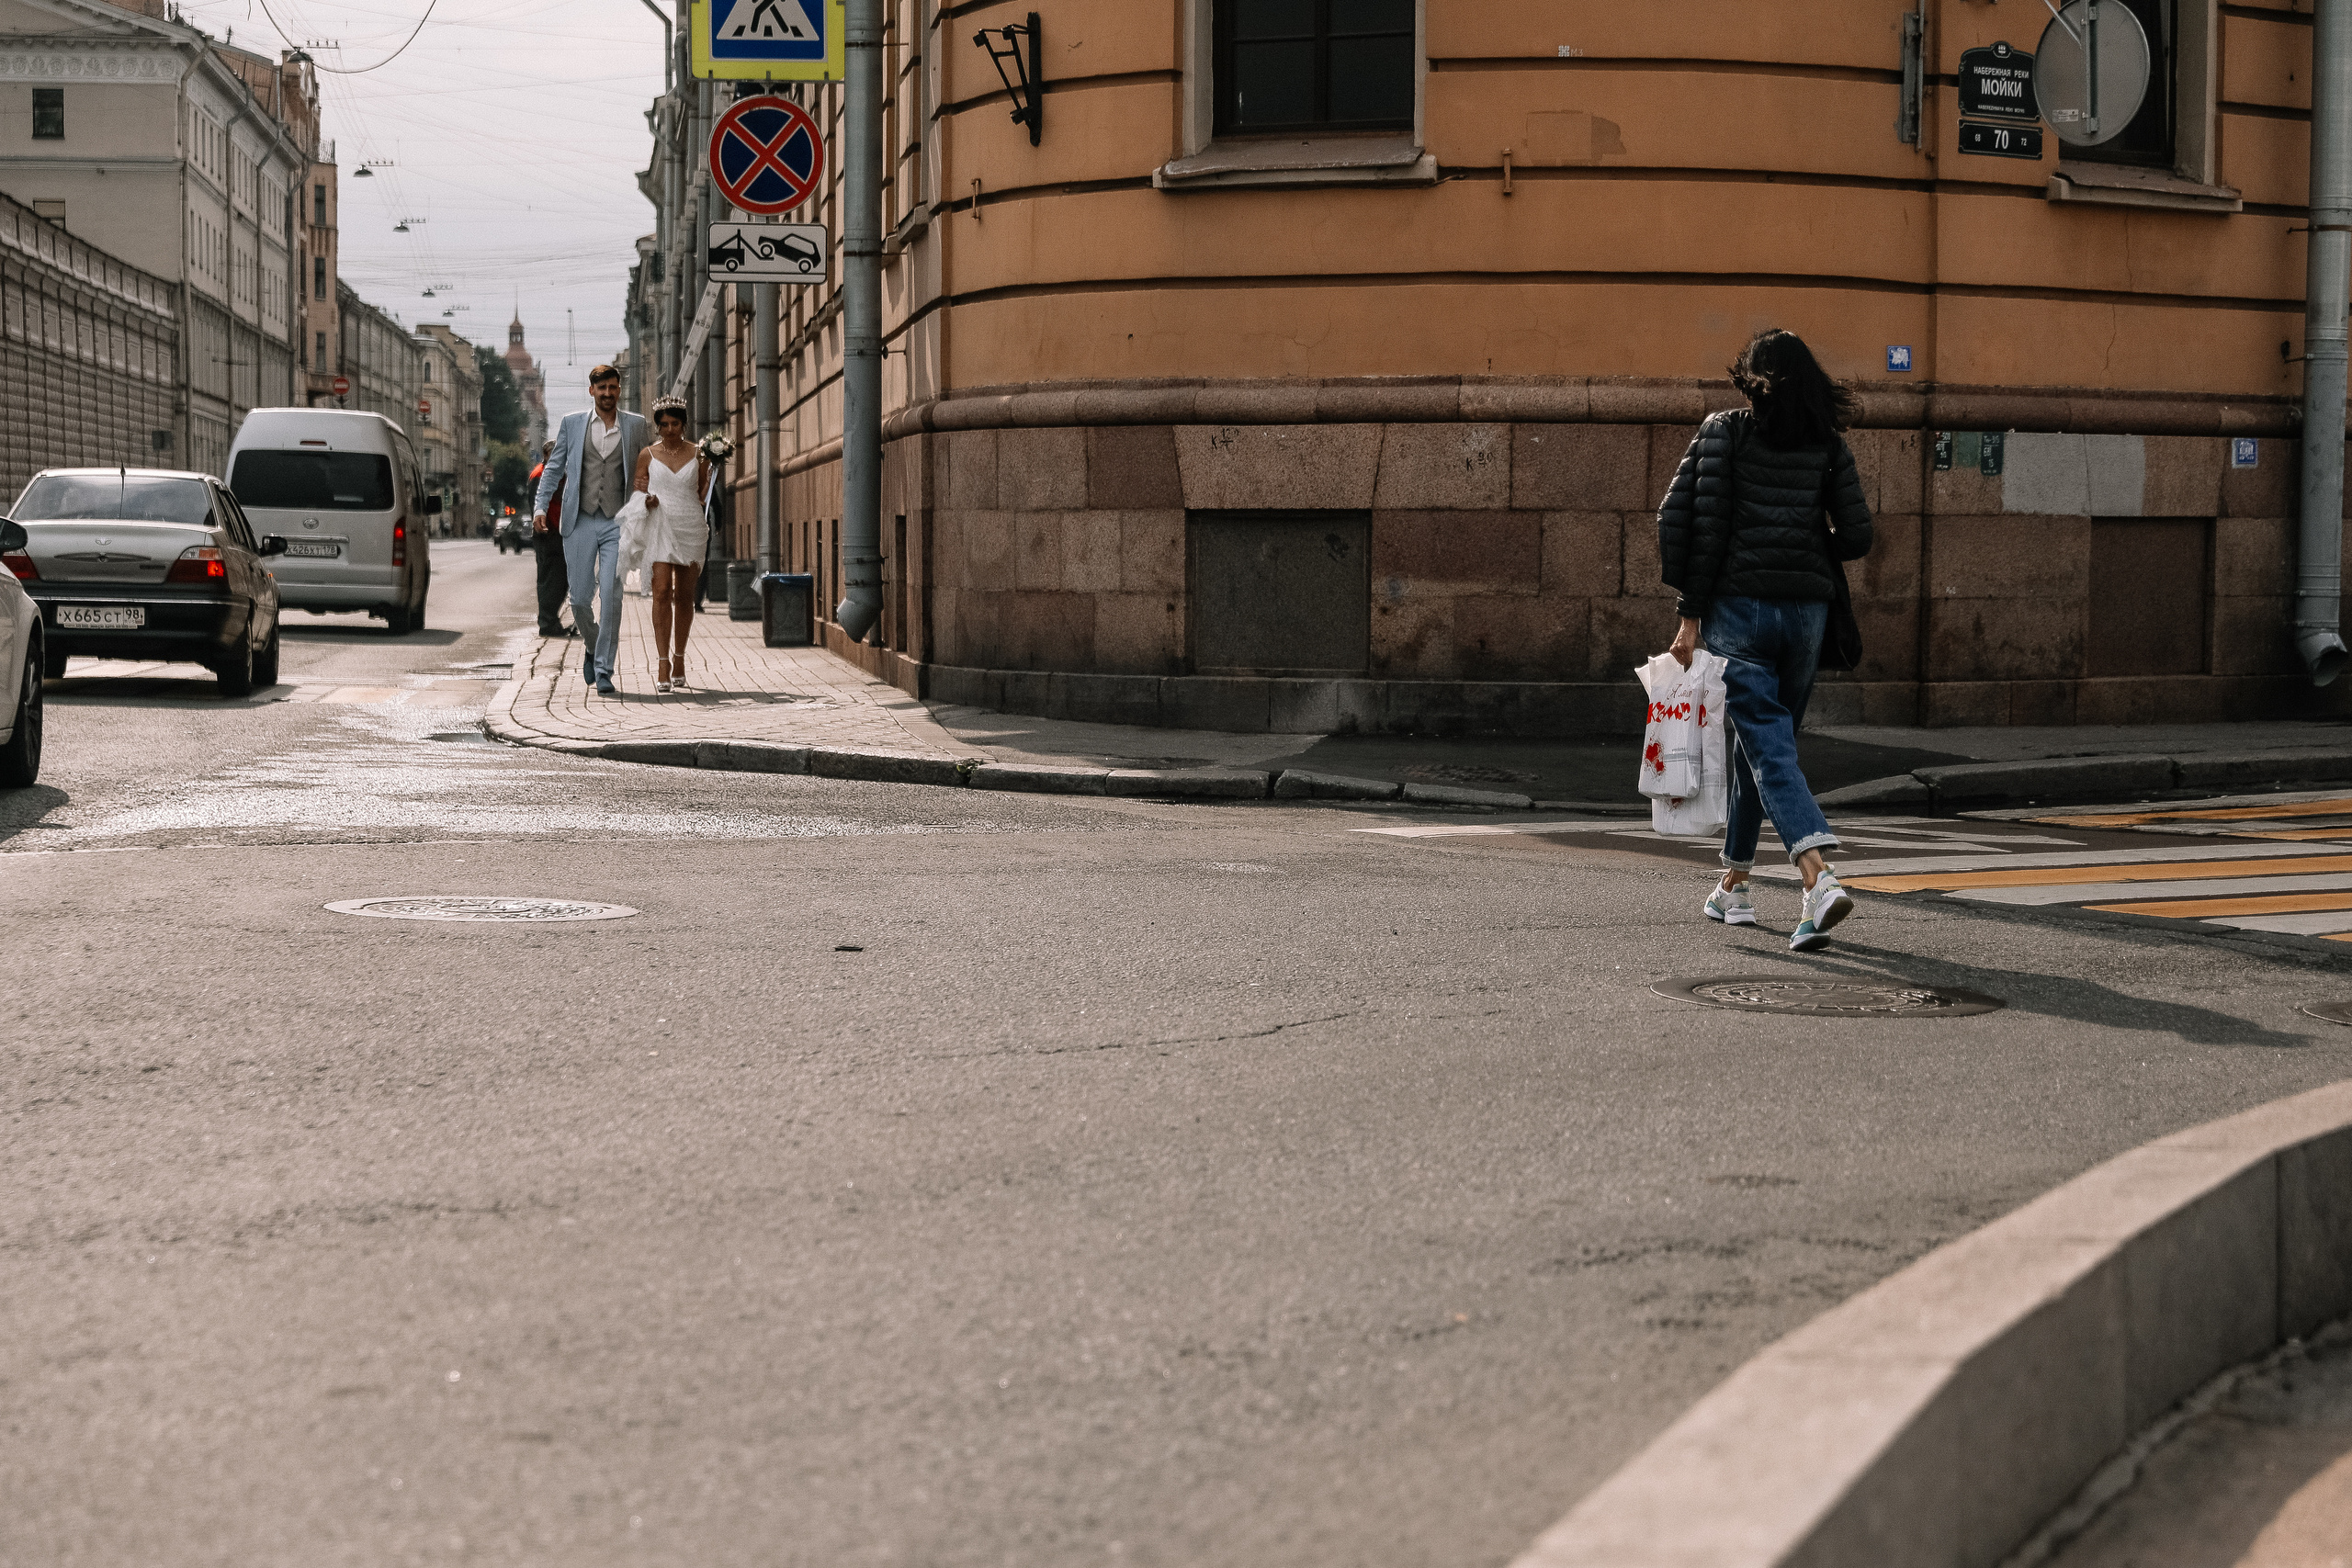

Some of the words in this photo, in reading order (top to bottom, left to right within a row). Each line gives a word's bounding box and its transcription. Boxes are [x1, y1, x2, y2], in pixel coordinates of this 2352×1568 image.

[1973, 66, 2011, 76] НАБЕРЕЖНАЯ
[2014, 70, 2030, 79] РЕКИ
[1982, 77, 2022, 97] МОЙКИ
[1974, 133, 1981, 142] 68
[1994, 130, 2009, 150] 70
[2020, 138, 2027, 146] 72
[125, 609, 140, 619] 98
